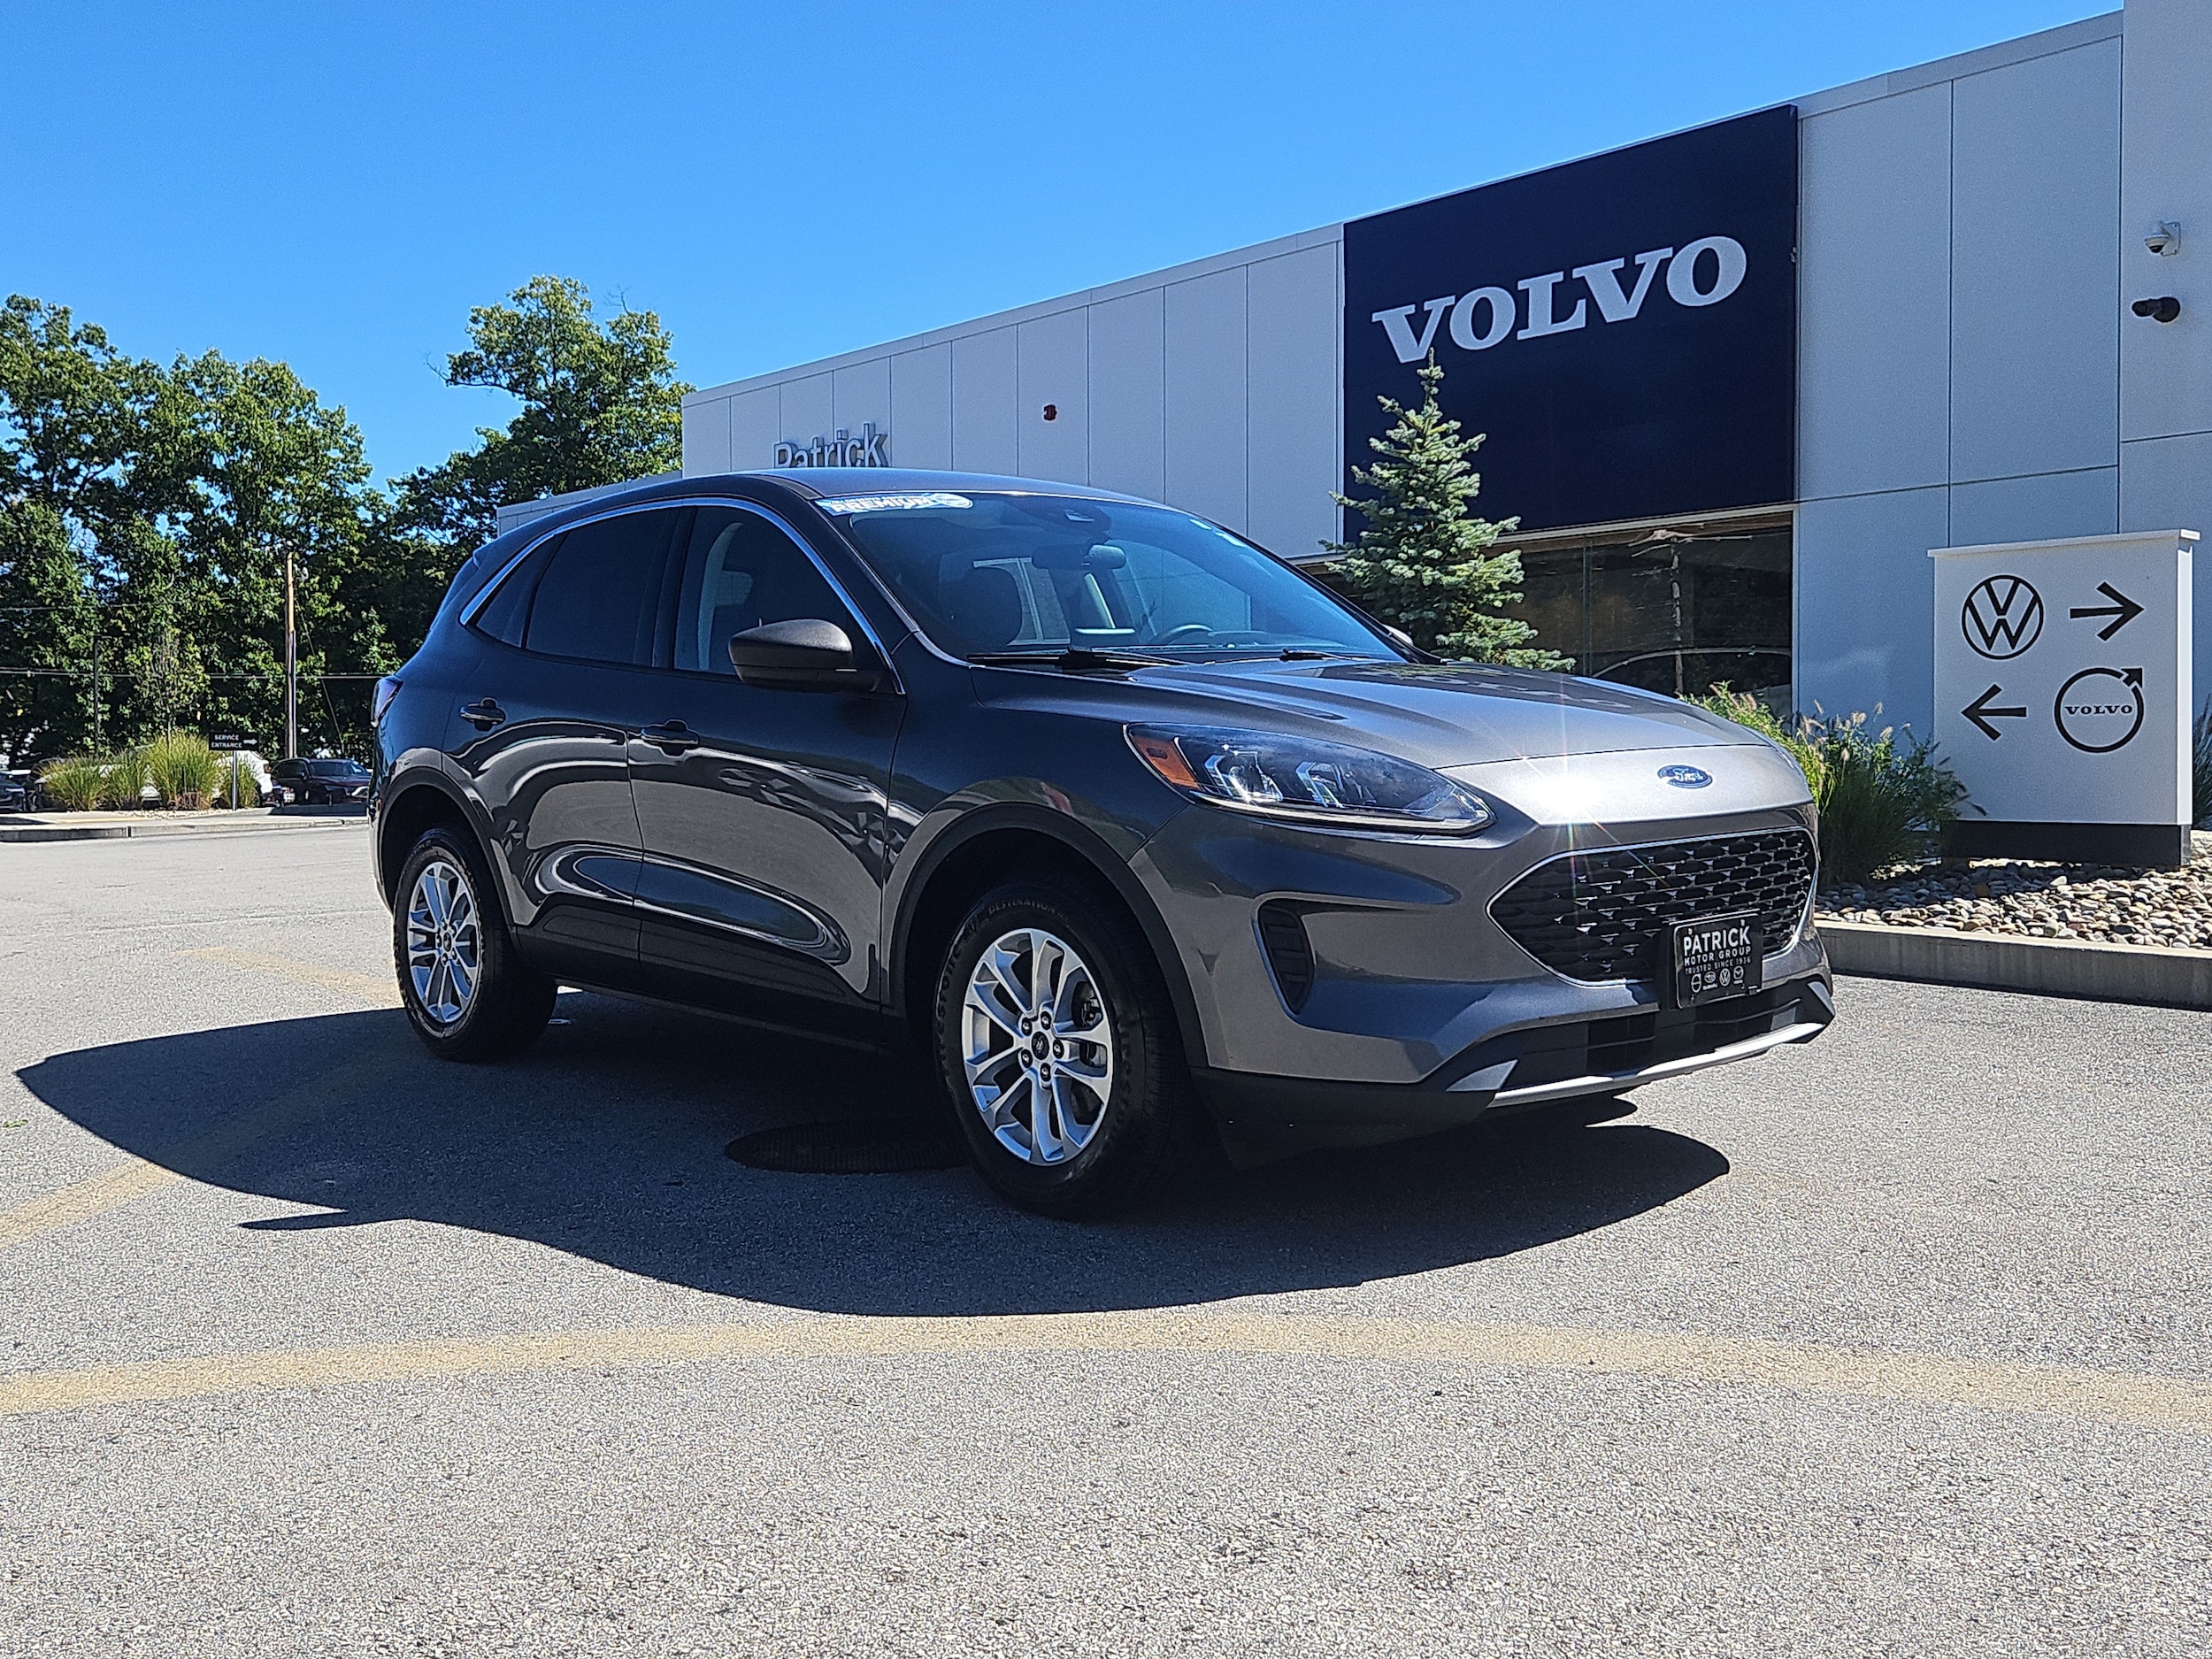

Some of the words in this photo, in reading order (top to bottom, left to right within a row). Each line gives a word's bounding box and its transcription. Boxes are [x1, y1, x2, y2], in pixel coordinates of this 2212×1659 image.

[1371, 235, 1747, 364] VOLVO
[773, 422, 889, 467] Patrick
[832, 497, 933, 512] PREMIUM
[2064, 704, 2133, 715] VOLVO
[1684, 926, 1751, 956] PATRICK
[1685, 952, 1714, 967] MOTOR
[1718, 946, 1751, 959] GROUP
[1686, 963, 1712, 975] TRUSTED
[1715, 957, 1733, 969] SINCE
[1736, 956, 1751, 965] 1936
